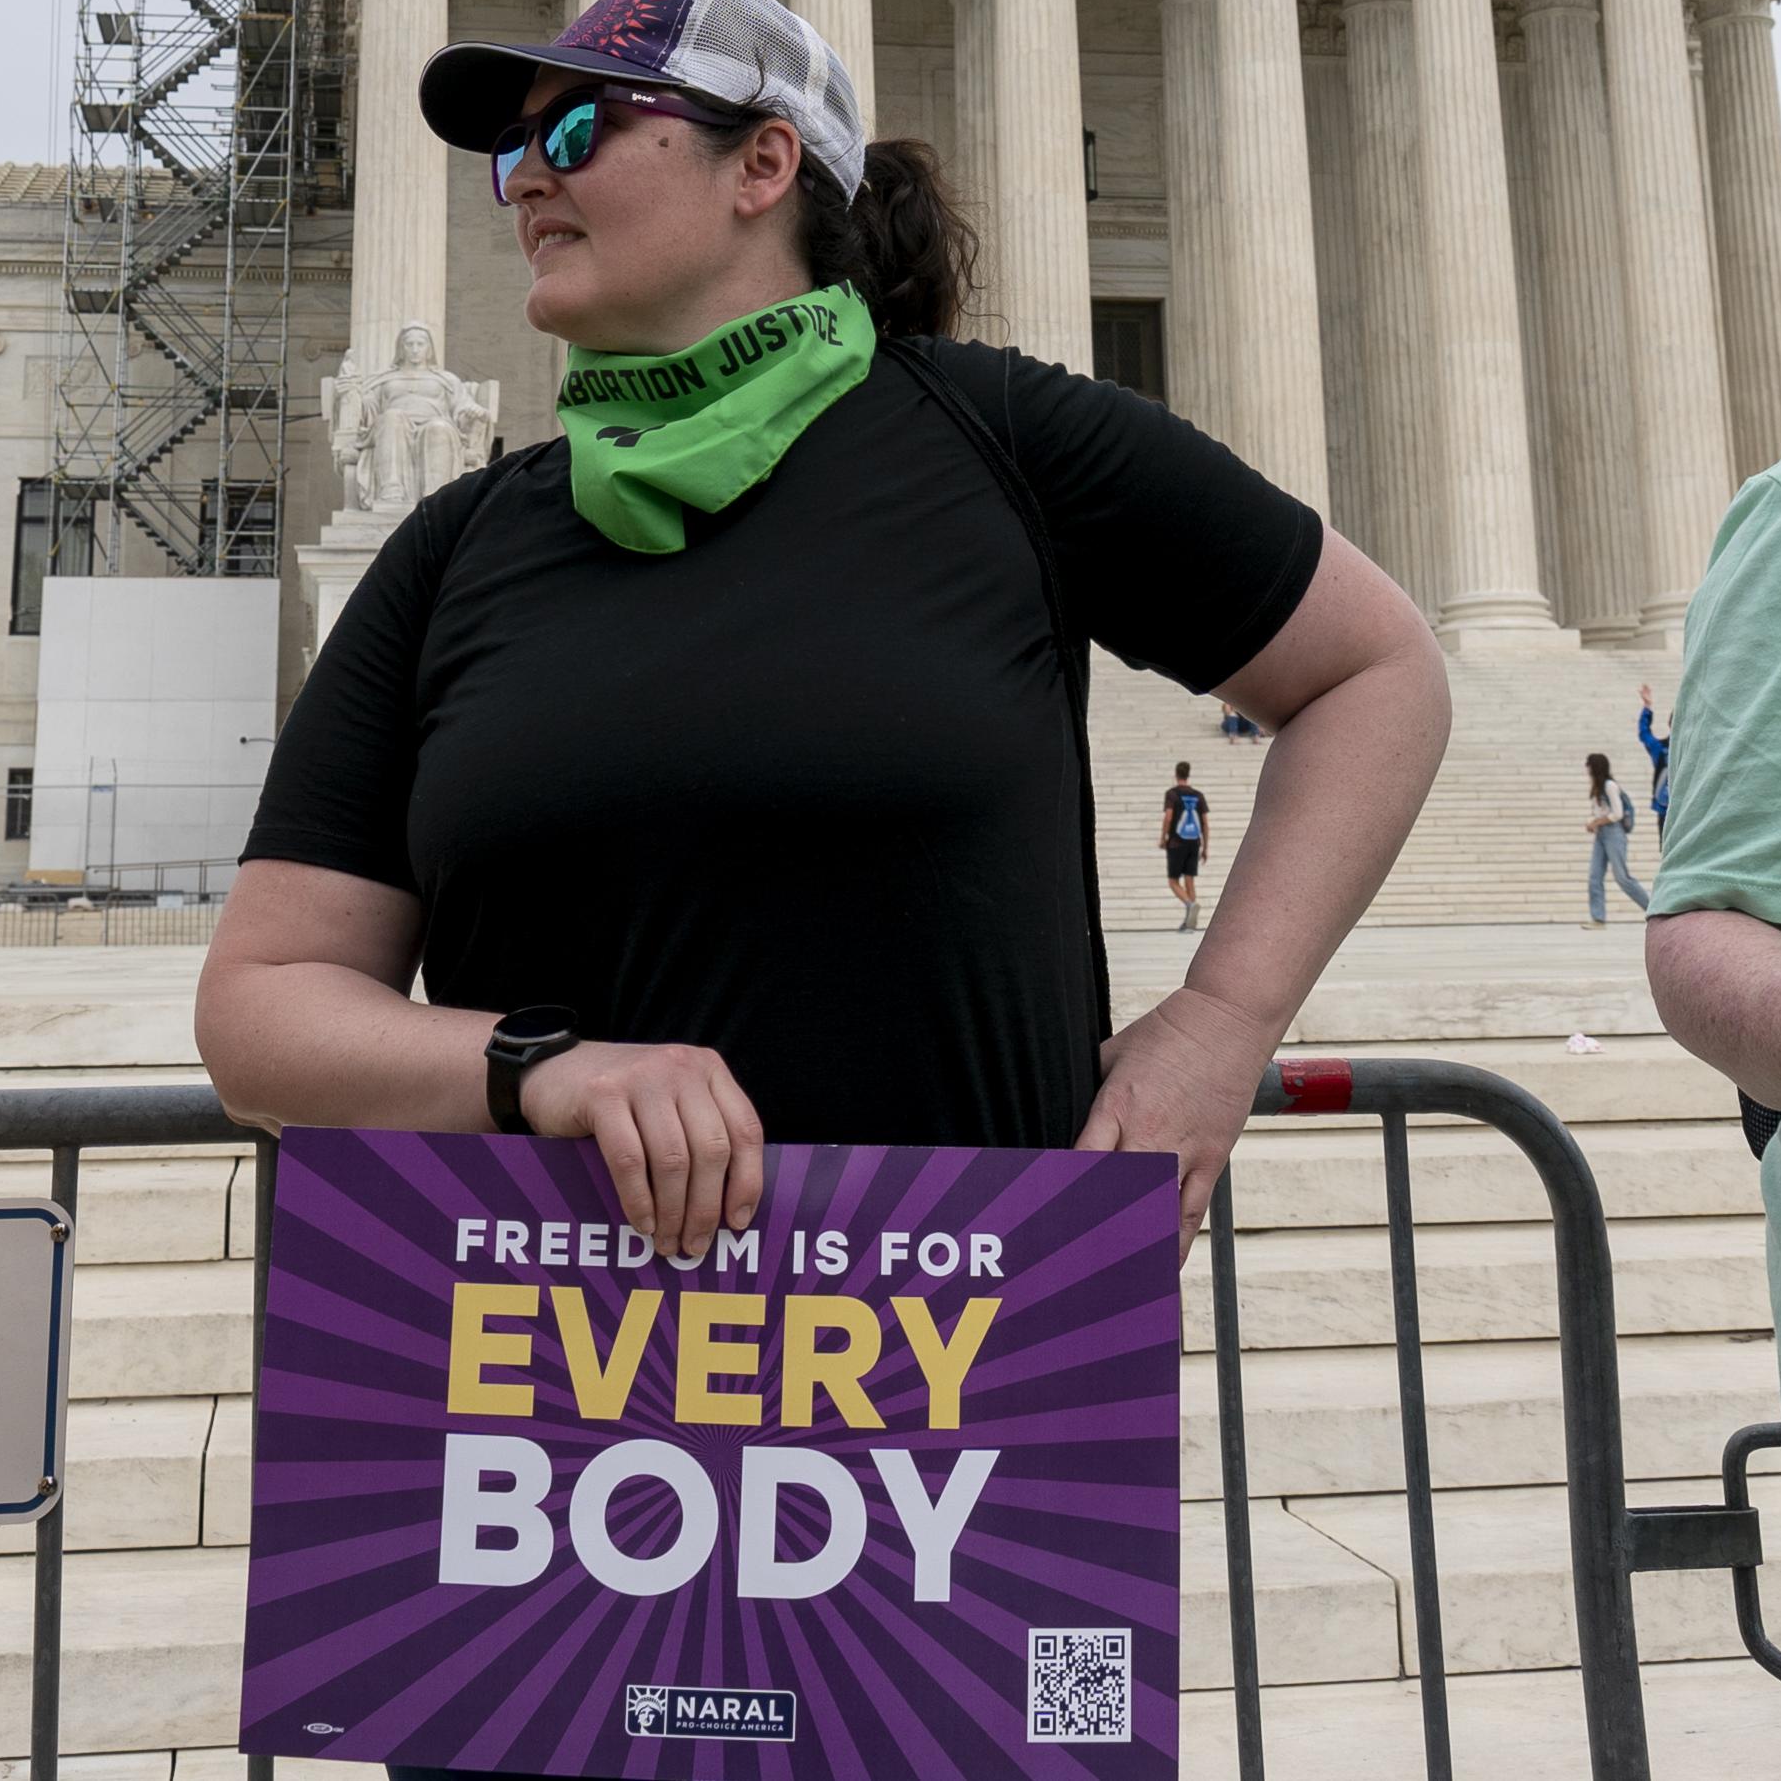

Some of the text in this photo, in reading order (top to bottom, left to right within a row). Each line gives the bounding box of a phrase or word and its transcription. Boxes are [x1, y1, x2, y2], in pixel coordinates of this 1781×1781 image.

[719, 304, 843, 377] JUSTICE
[793, 1230, 849, 1275] IS
[880, 1232, 1005, 1277] FOR
[447, 1282, 1003, 1430] EVERY
[438, 1433, 1000, 1603] BODY
[676, 1696, 784, 1721] NARAL
[676, 1721, 784, 1731] PRO-CHOICE AMERICA
